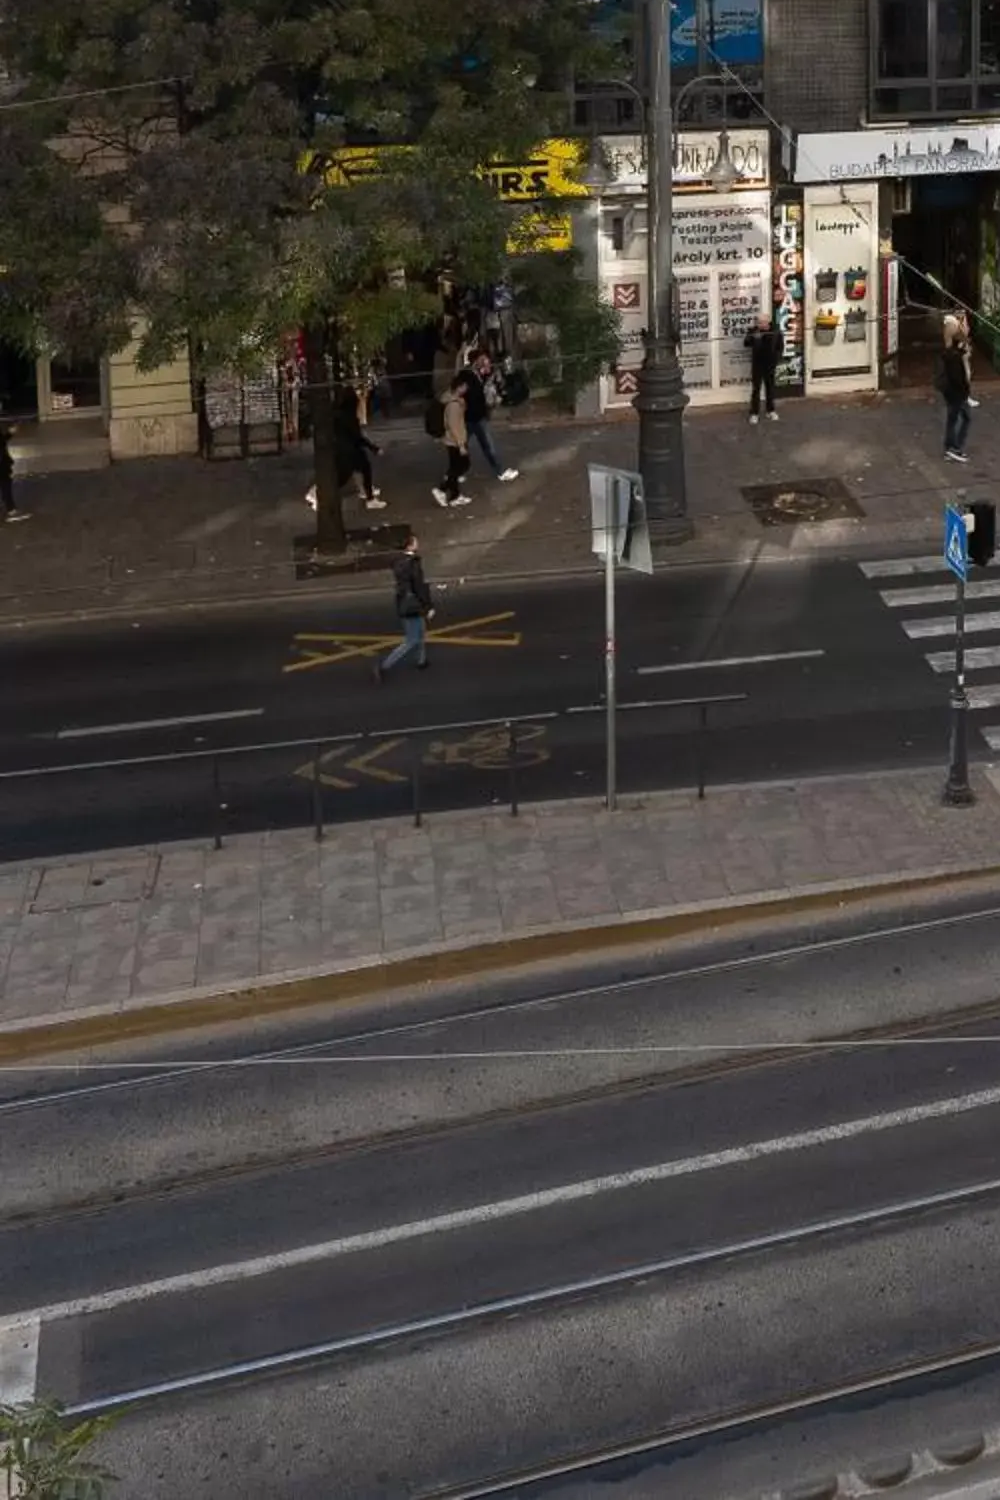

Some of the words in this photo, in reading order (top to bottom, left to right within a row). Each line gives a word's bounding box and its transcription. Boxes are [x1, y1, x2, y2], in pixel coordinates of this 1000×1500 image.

[830, 158, 908, 179] BUDAPEST
[672, 206, 764, 220] xpress-pcr.com
[672, 223, 717, 236] Testing
[720, 221, 753, 233] Point
[673, 250, 711, 264] ároly
[715, 248, 742, 262] krt.
[747, 246, 763, 259] 10
[779, 204, 798, 357] LUGGAGE
